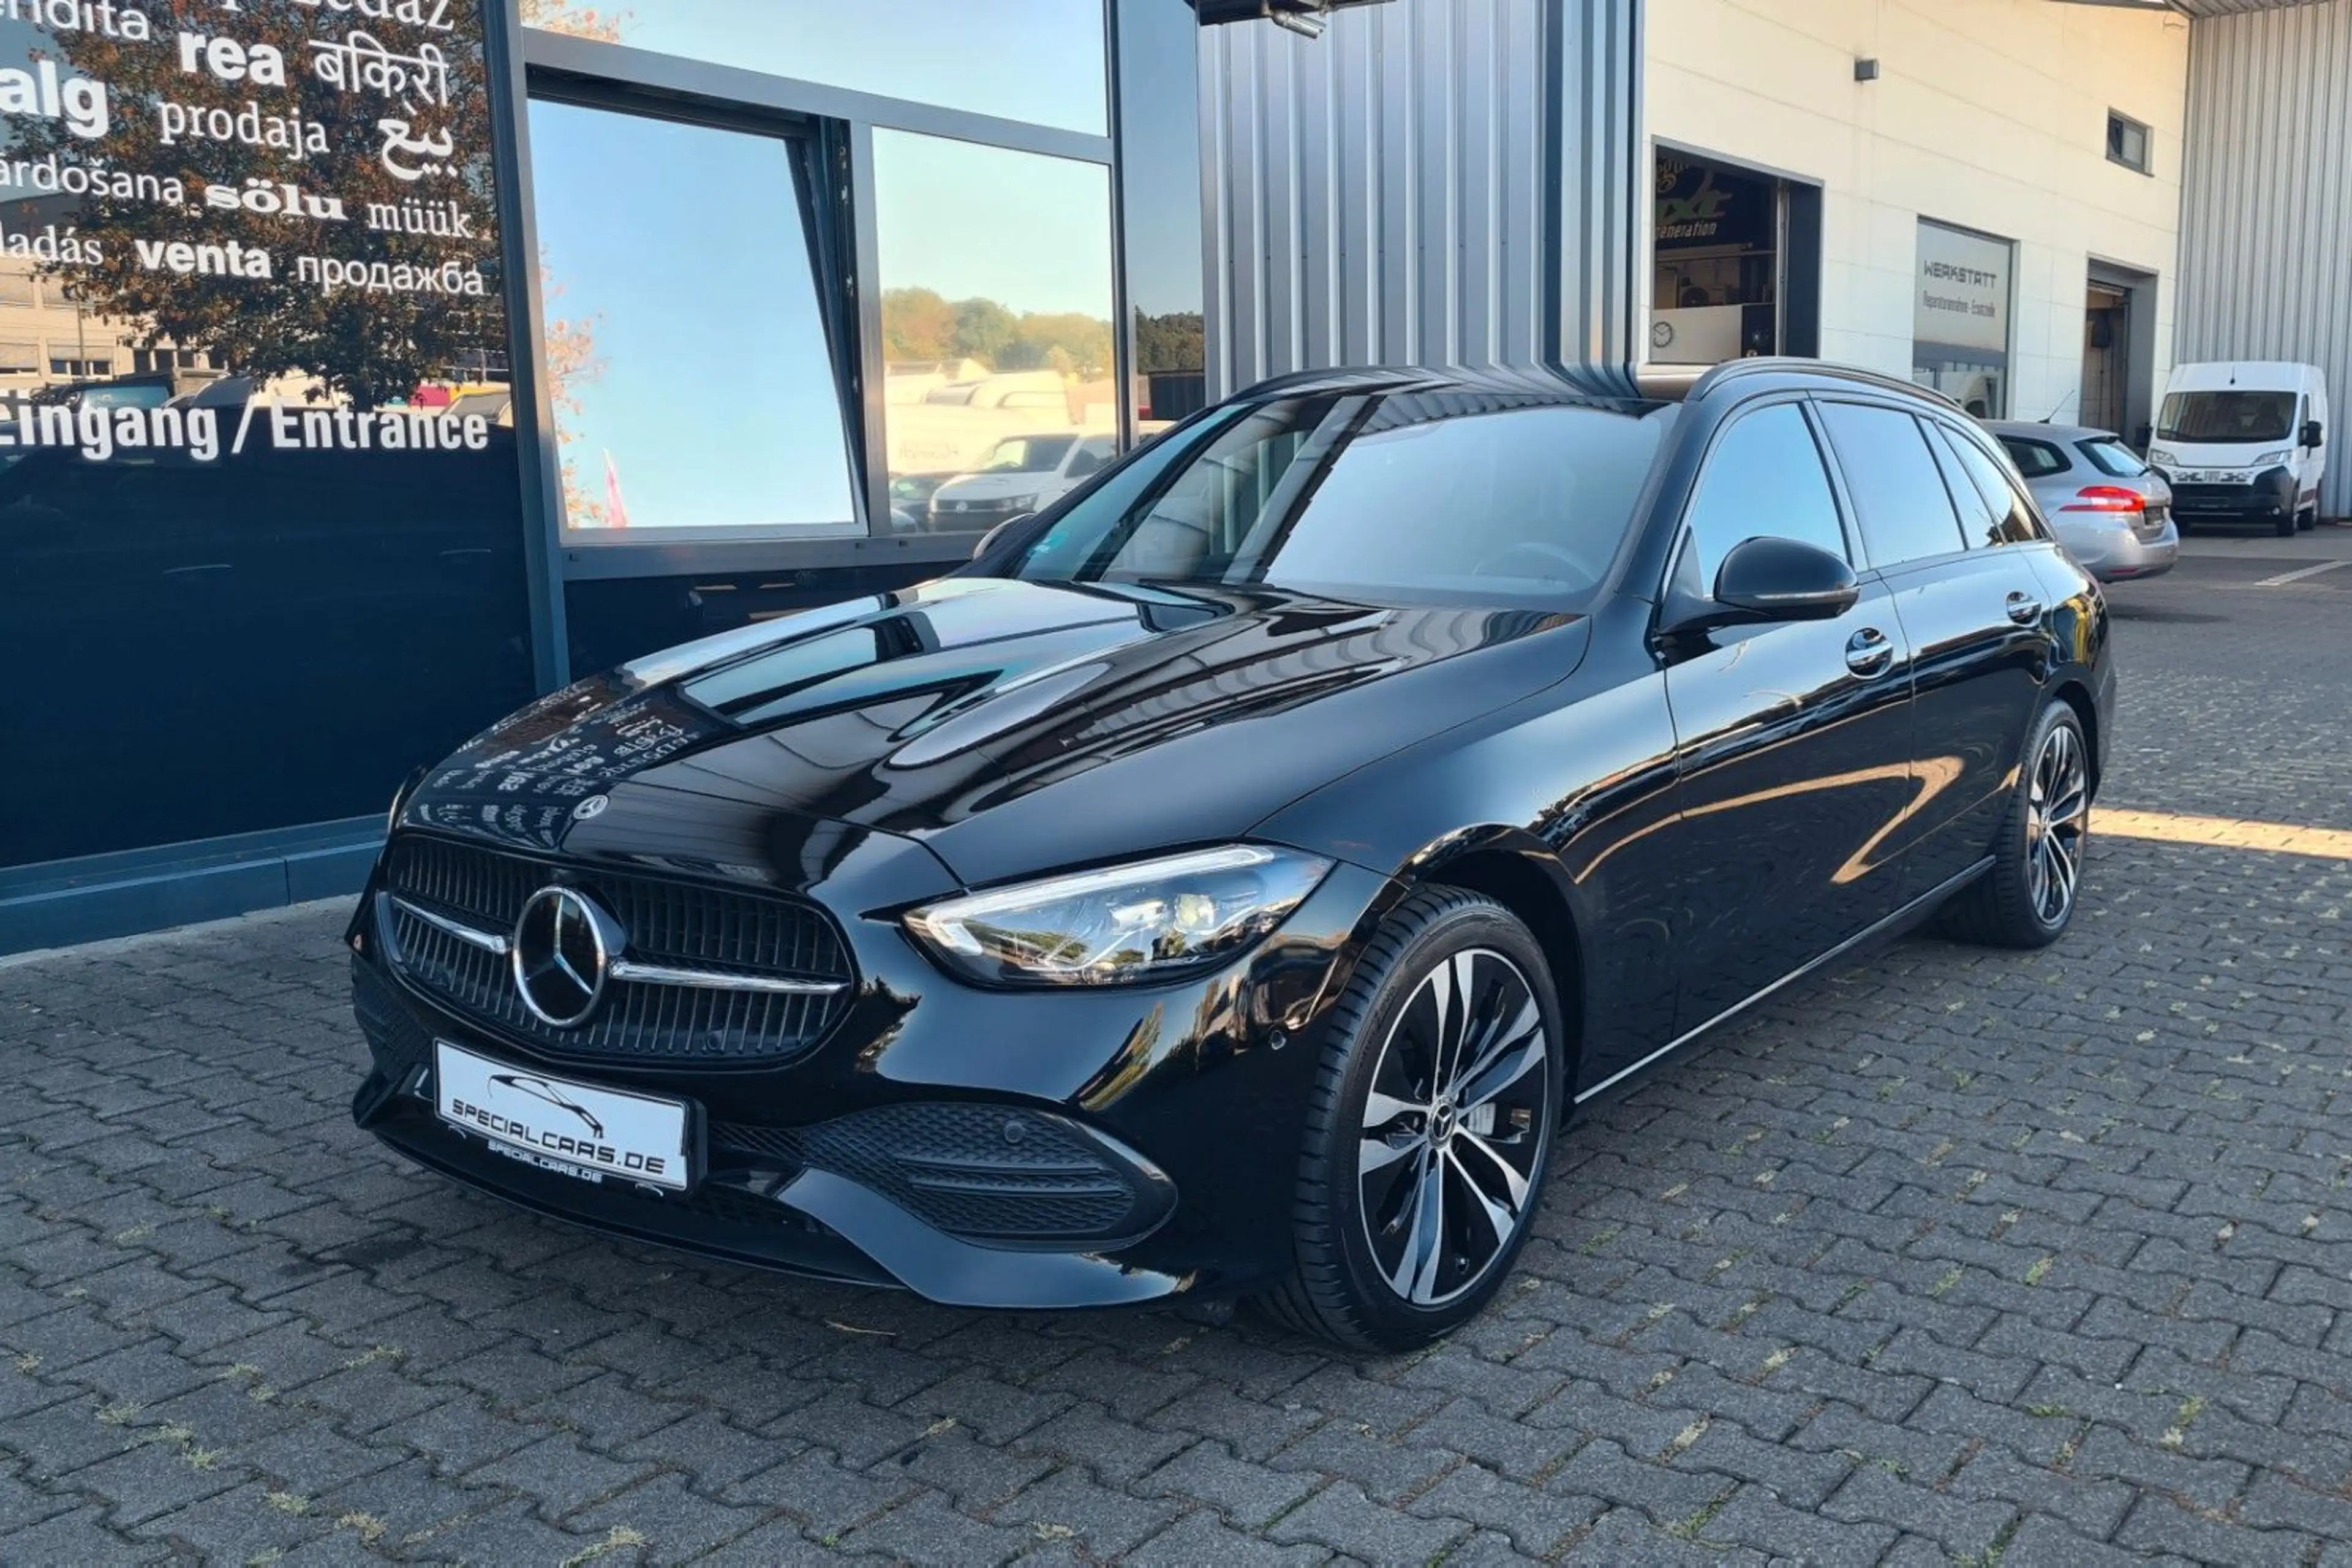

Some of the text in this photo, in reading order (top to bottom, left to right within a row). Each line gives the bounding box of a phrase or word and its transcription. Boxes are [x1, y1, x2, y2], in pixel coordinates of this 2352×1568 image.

[0, 0, 149, 40] ndita
[179, 32, 286, 87] rea
[0, 59, 108, 138] alg
[156, 100, 330, 161] prodaja
[378, 119, 458, 180] بيع
[205, 178, 349, 222] sölu
[368, 201, 475, 240] müük
[135, 239, 272, 279] venta
[298, 254, 485, 297] продажба
[1924, 259, 1997, 289] WERKSTATT
[271, 396, 489, 451] Entrance
[452, 1098, 666, 1175] SPECIALCARS.DE
